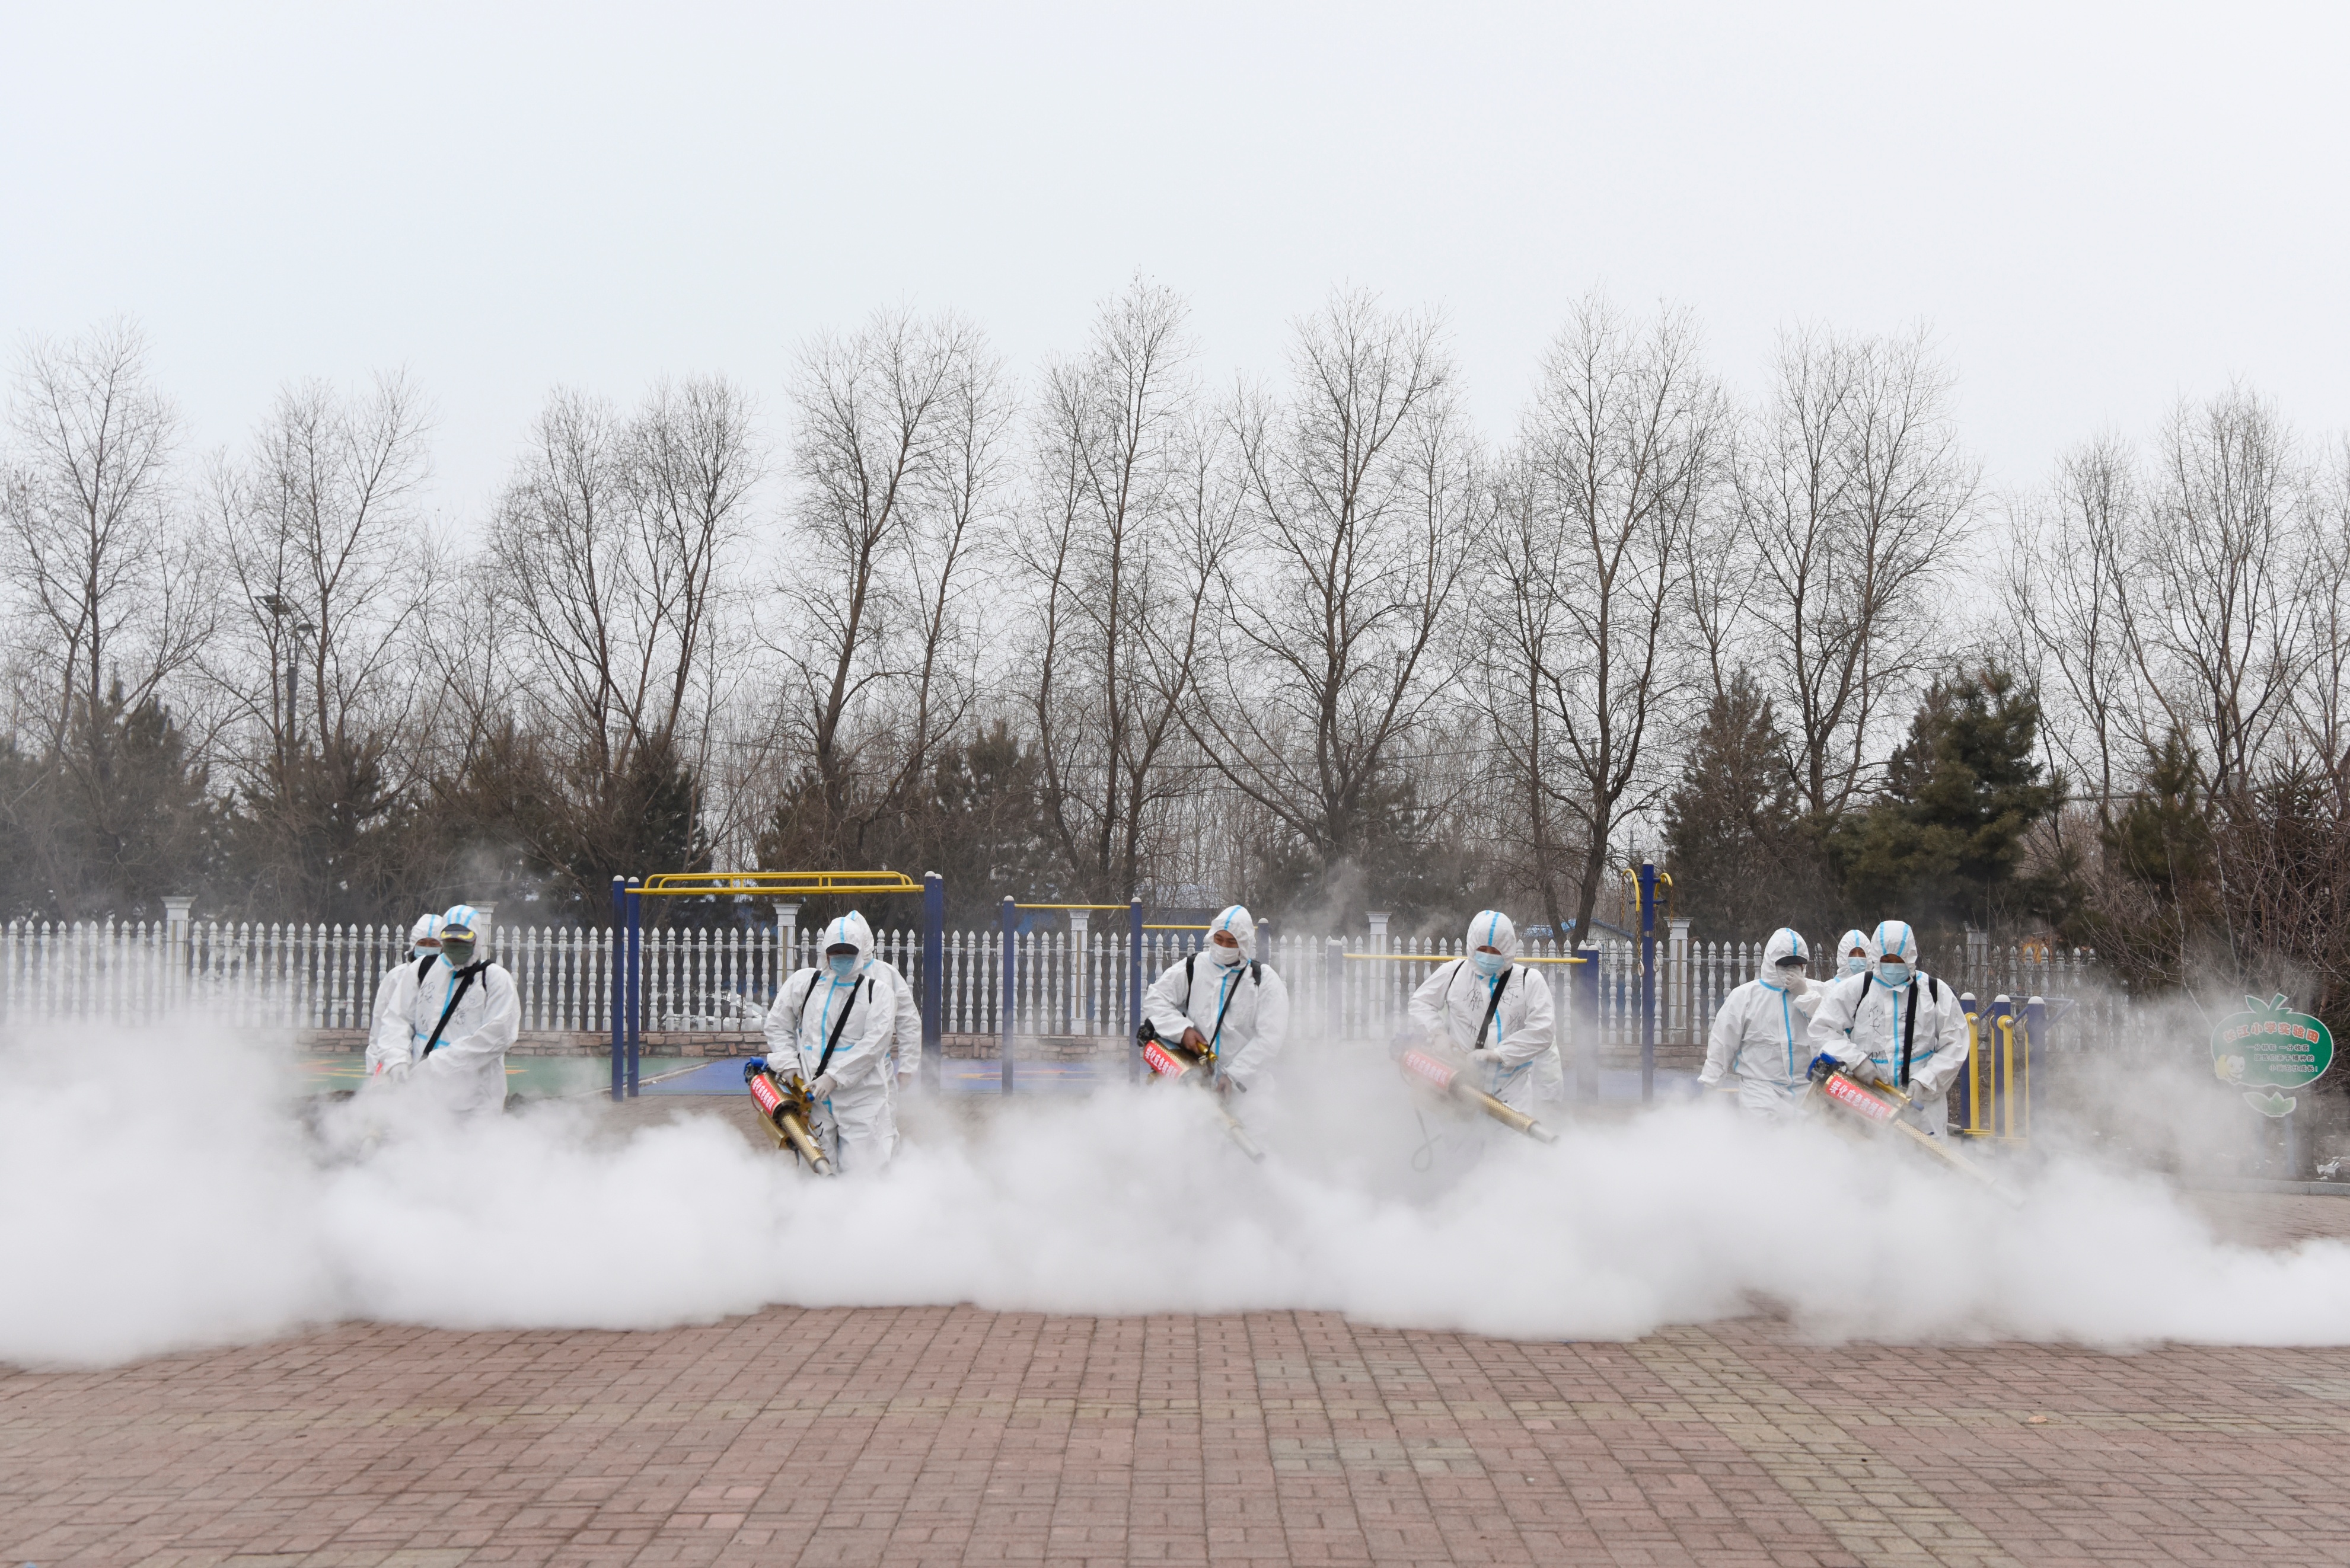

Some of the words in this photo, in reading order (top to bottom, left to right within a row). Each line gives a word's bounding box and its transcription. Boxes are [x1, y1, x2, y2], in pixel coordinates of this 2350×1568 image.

[2224, 1021, 2319, 1043] 长江小学实验田
[1829, 1080, 1886, 1119] 绥化应急救援队
